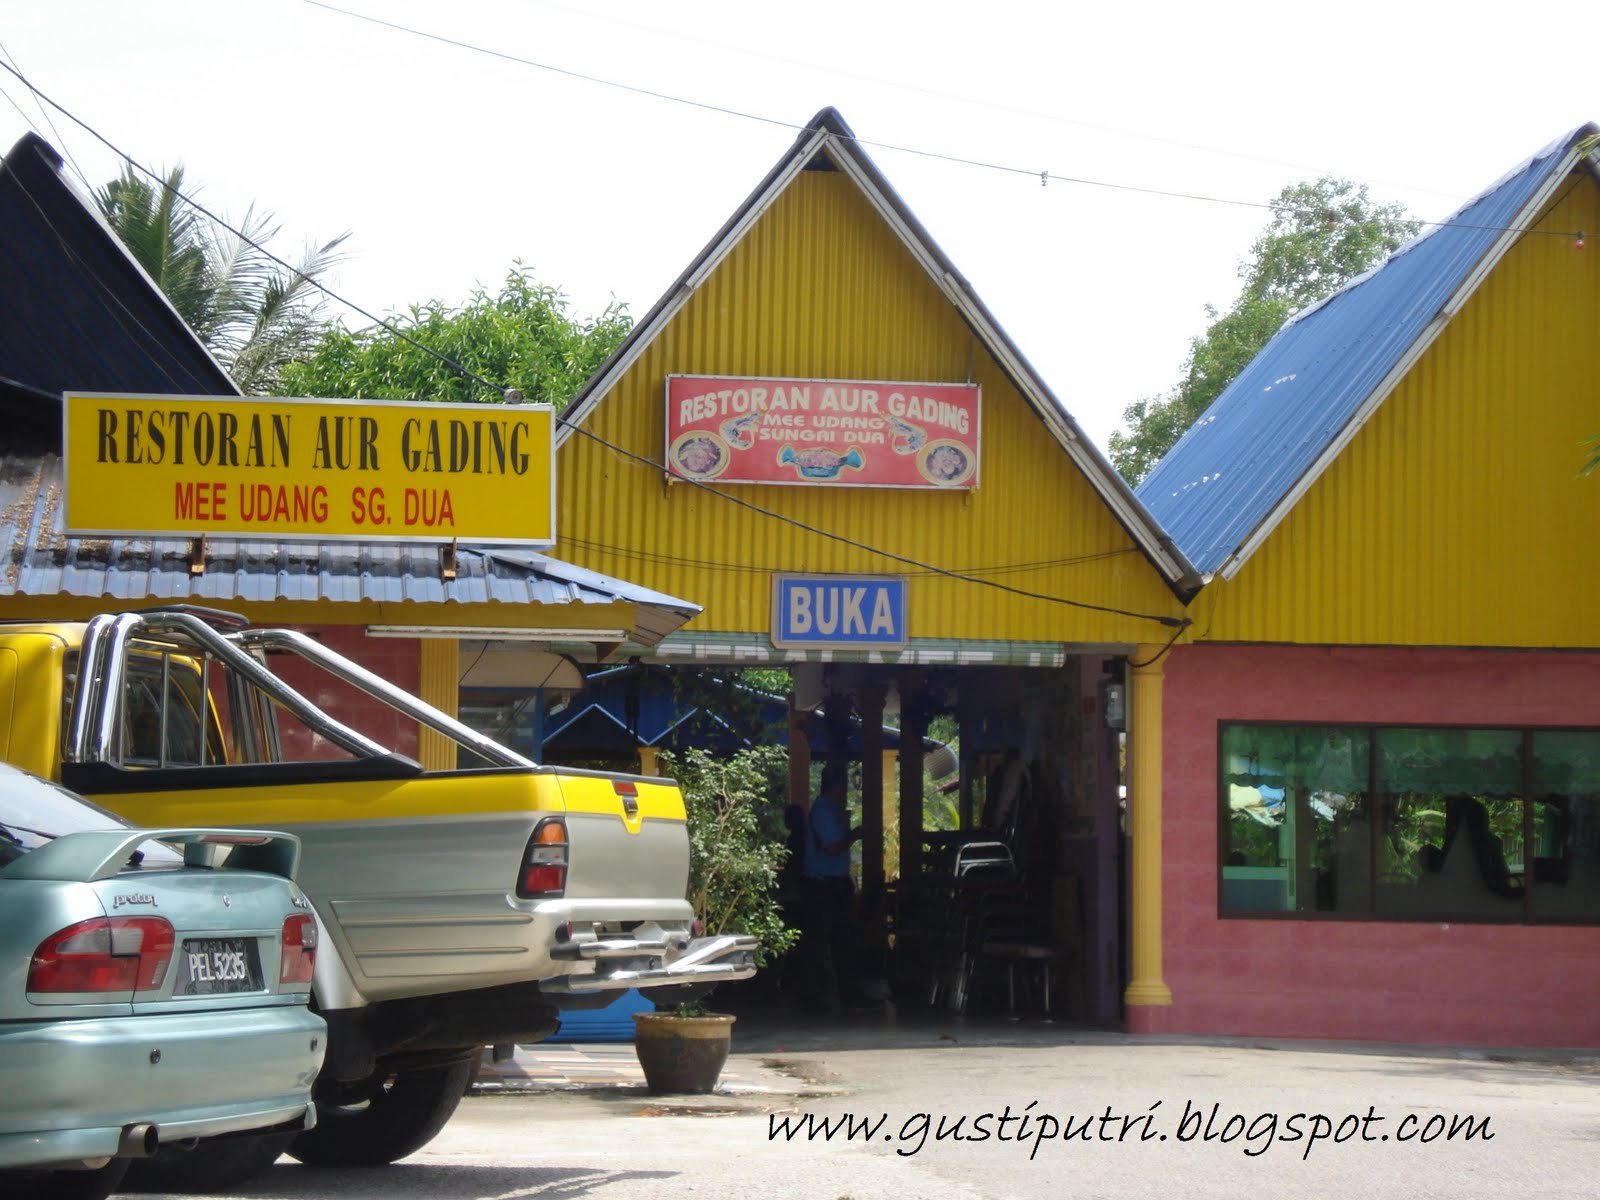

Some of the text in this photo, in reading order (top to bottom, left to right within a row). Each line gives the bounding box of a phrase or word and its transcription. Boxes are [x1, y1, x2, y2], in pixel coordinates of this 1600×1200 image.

[680, 386, 970, 435] RESTORAN AUR GADING
[763, 413, 885, 430] MEE UDANG
[96, 408, 530, 476] RESTORAN AUR GADING
[759, 427, 885, 445] SUNGAI DUA
[174, 481, 456, 527] MEE UDANG SG. DUA
[789, 586, 895, 636] BUKA
